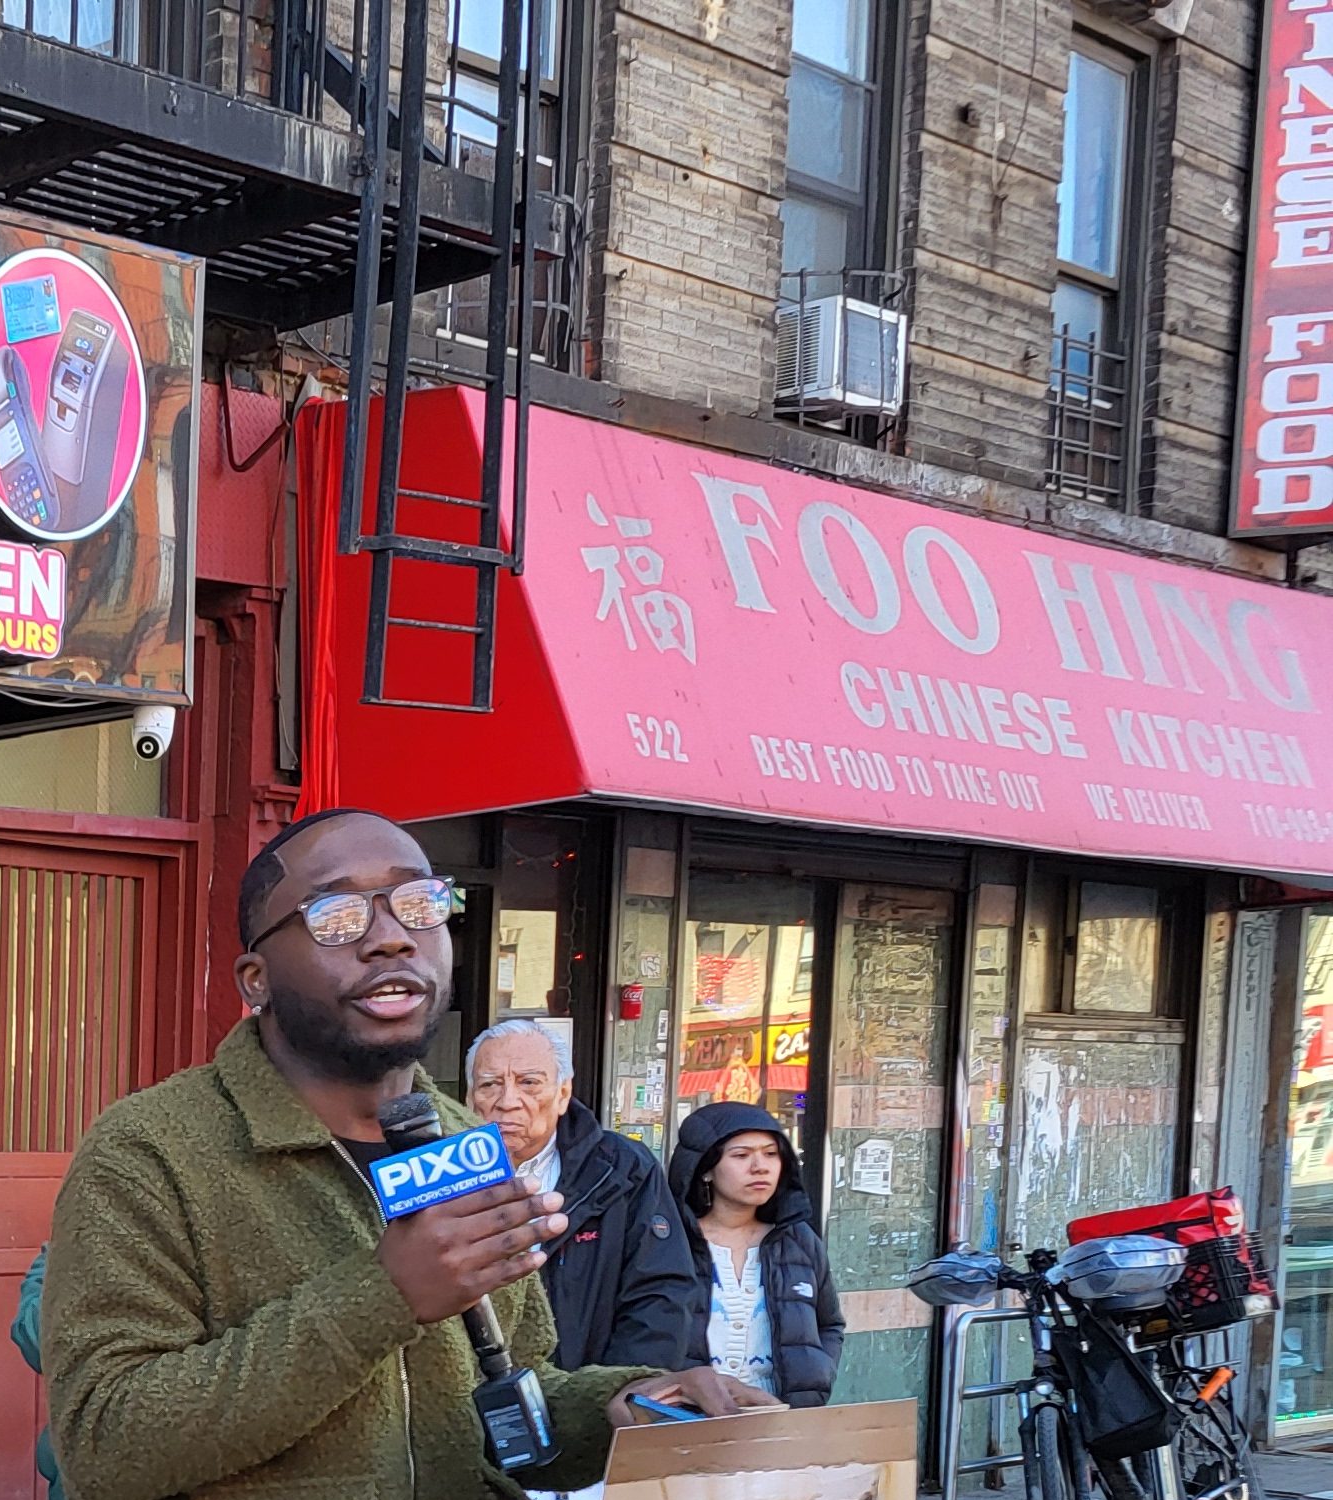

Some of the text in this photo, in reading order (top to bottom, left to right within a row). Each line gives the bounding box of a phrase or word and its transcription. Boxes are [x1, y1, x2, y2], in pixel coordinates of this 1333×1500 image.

[1253, 0, 1333, 516] INESE FOOD
[580, 492, 697, 666] 福
[690, 471, 1322, 714] FOO HING
[626, 712, 690, 764] 522
[840, 661, 1316, 790] CHINESE KITCHEN
[749, 734, 821, 783] BEST
[823, 745, 896, 792] FOOD
[895, 755, 934, 797] TO
[933, 760, 998, 806] TAKE
[998, 770, 1046, 813] OUT
[1084, 782, 1123, 822] WE
[1121, 787, 1213, 832] DELIVER
[377, 1143, 466, 1197] PIX
[388, 1199, 414, 1213] NEW
[451, 1176, 479, 1192] VERY
[478, 1168, 506, 1184] OWN
